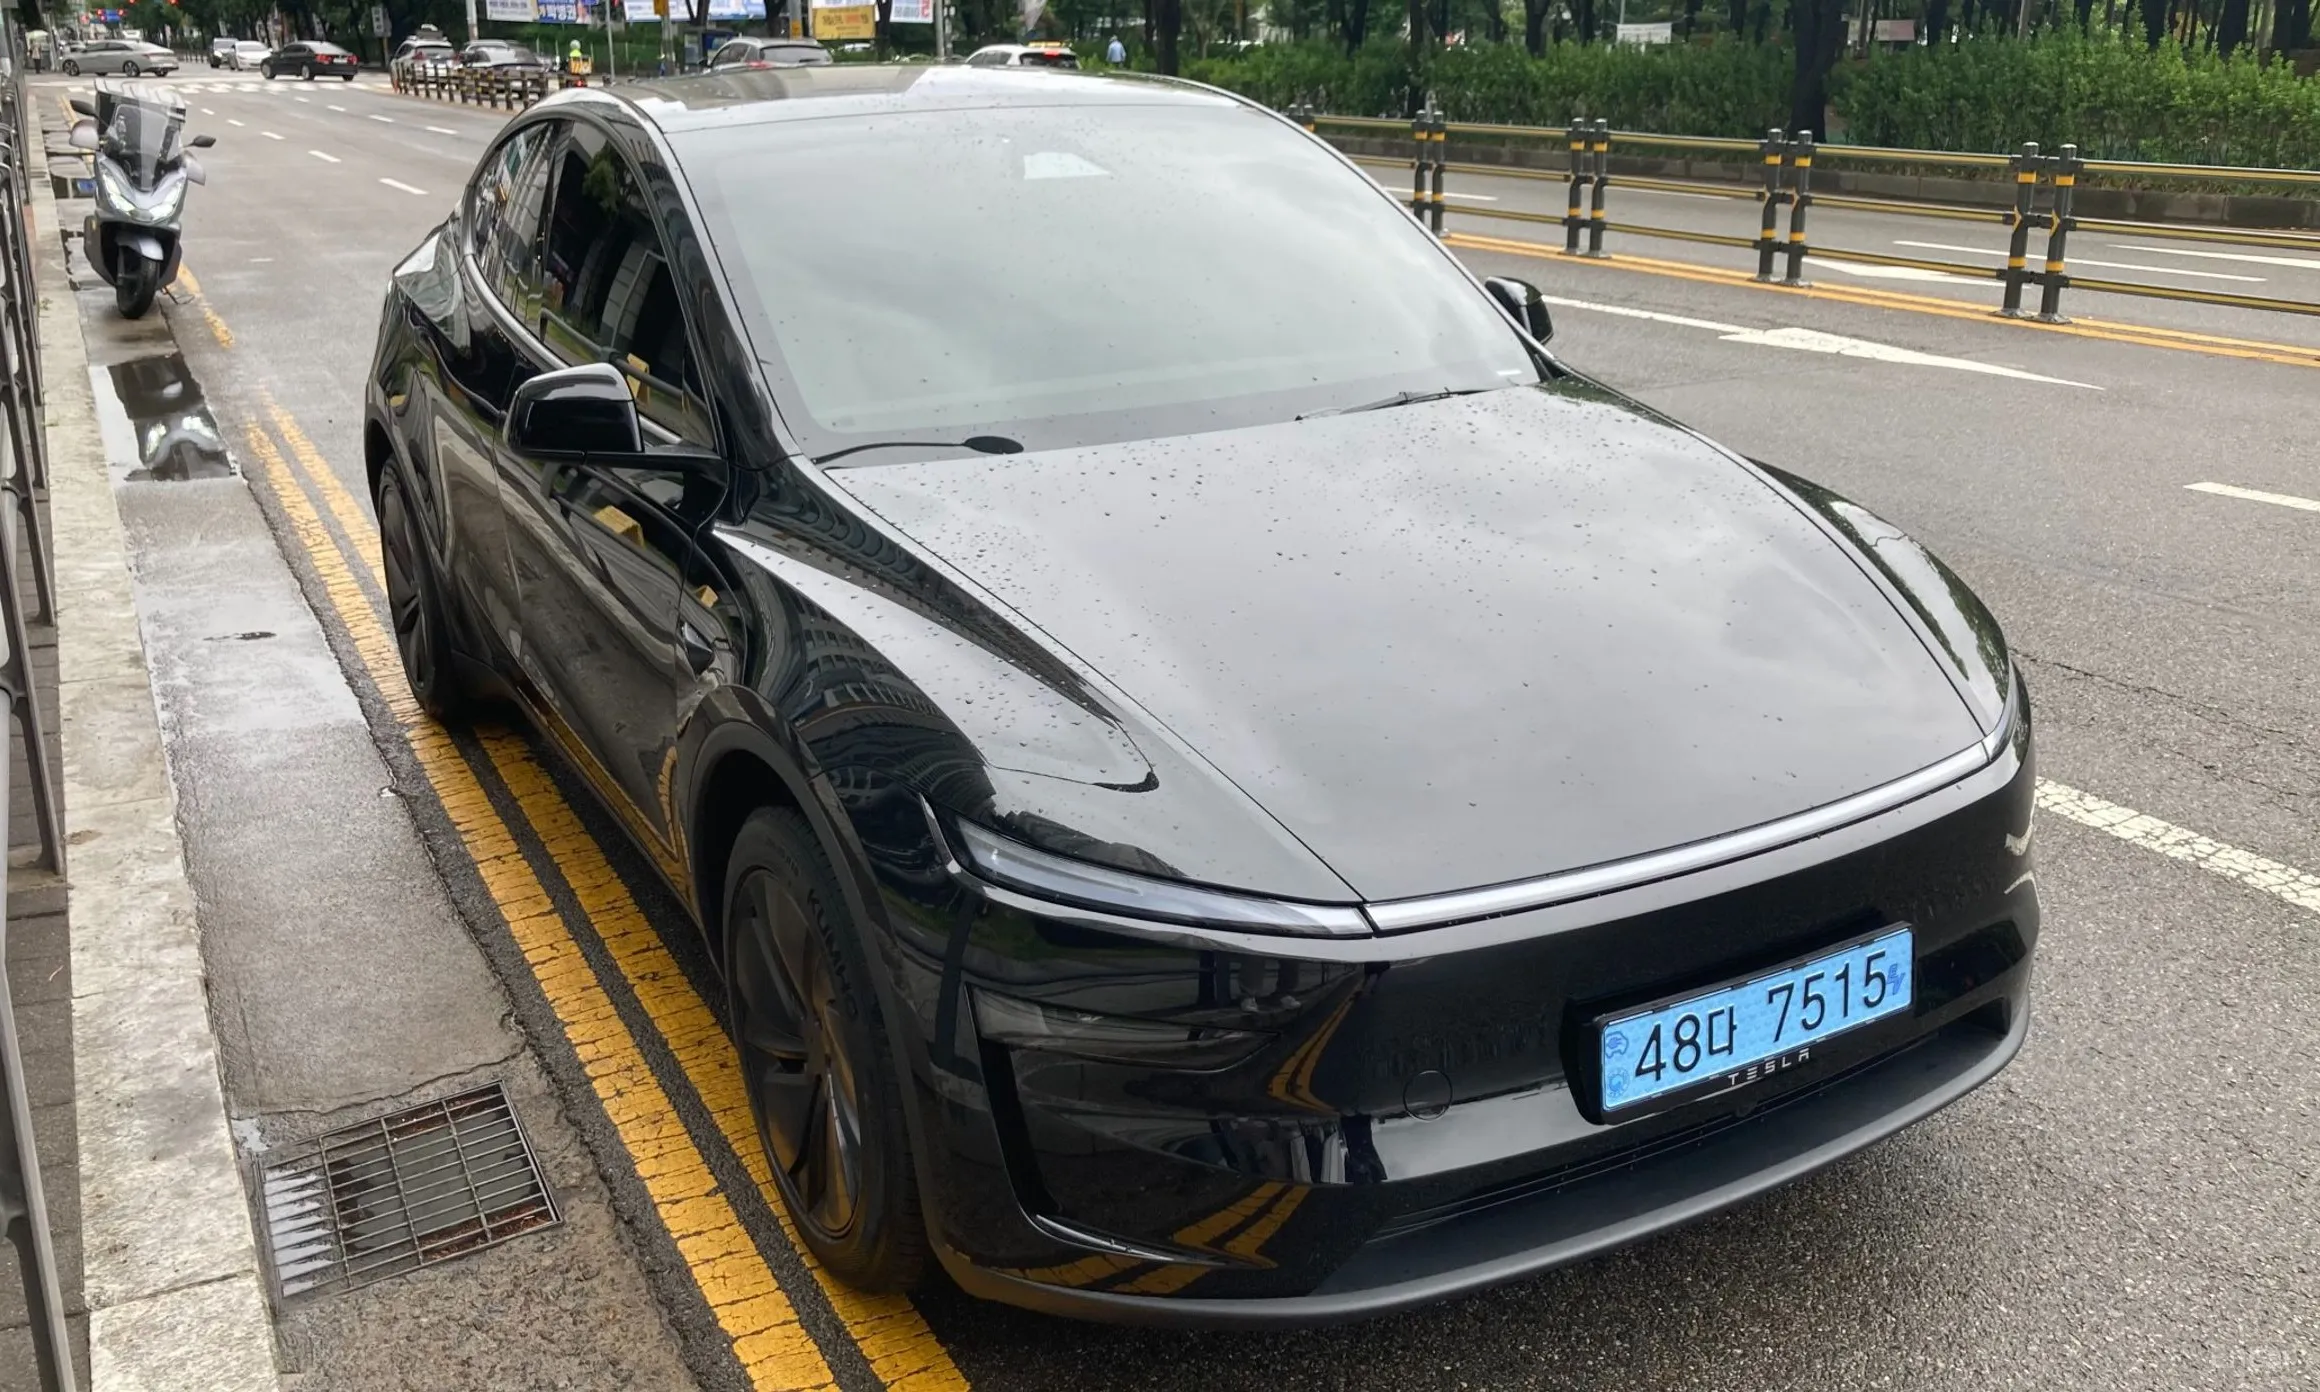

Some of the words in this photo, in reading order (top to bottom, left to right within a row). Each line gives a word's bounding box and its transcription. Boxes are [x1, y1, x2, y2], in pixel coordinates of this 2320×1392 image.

[1635, 1005, 1738, 1082] 48다
[1767, 950, 1888, 1043] 7515
[1728, 1048, 1812, 1086] TESLA
